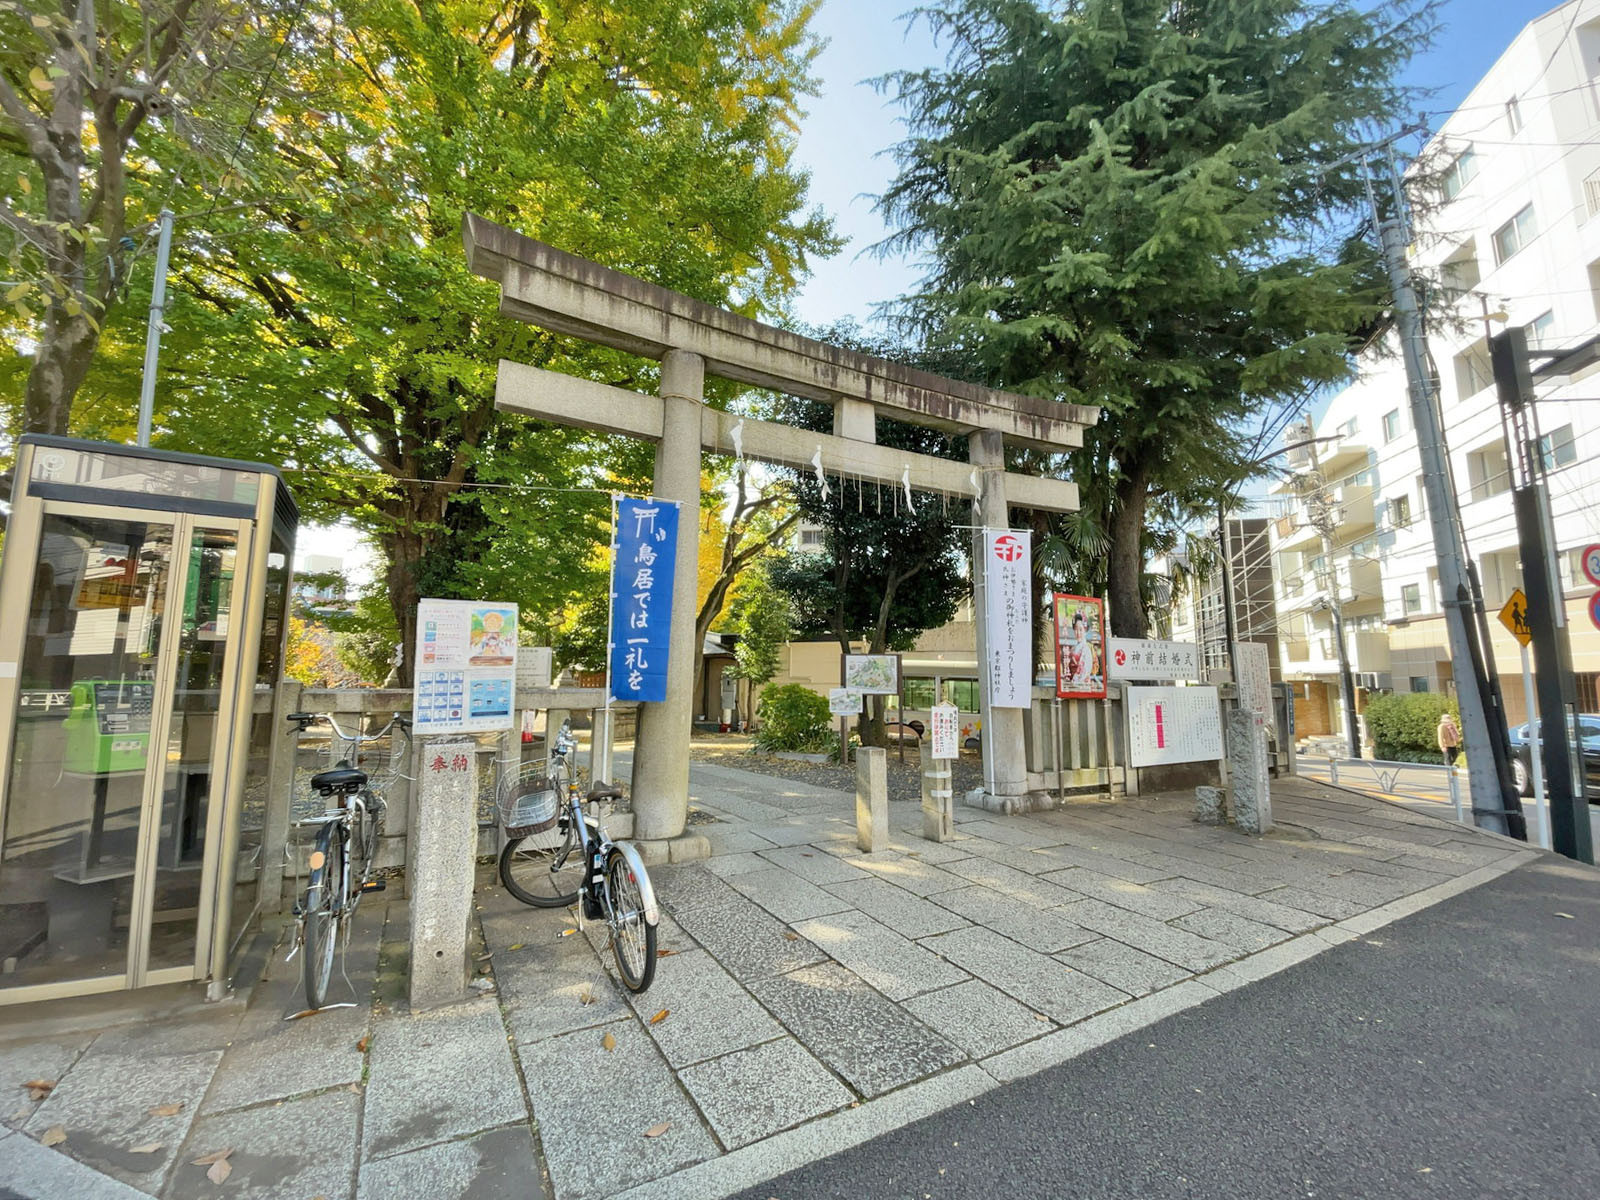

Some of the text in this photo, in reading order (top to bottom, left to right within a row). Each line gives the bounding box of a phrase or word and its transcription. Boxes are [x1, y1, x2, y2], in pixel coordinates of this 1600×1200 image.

[624, 543, 658, 690] 鳥居では一礼を
[1090, 608, 1100, 644] 七五三
[1131, 650, 1193, 667] 神前結婚式
[430, 754, 468, 774] 奉納
